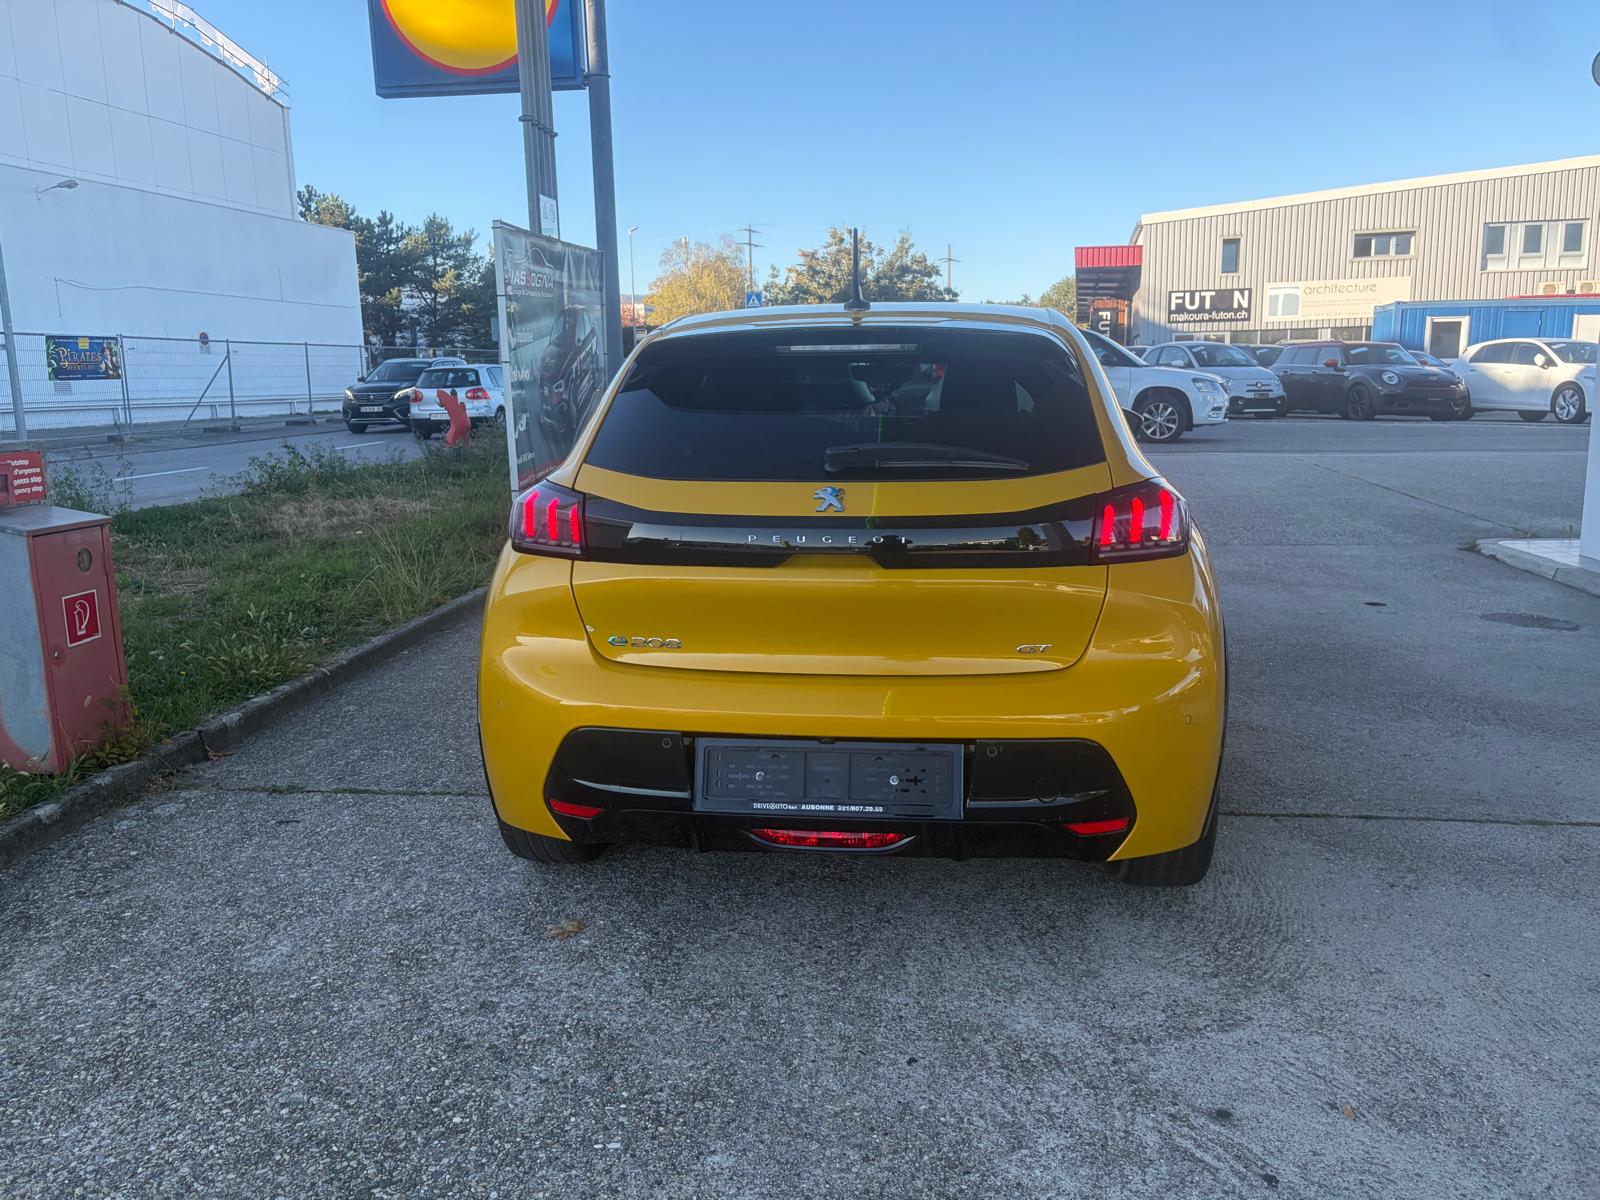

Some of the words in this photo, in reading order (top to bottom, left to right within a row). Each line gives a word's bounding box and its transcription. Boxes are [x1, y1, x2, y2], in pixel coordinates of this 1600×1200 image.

[1303, 283, 1377, 295] architecture
[1170, 310, 1248, 322] makoura-futon.ch
[748, 534, 911, 544] PEUGEOT
[1016, 644, 1053, 654] GT
